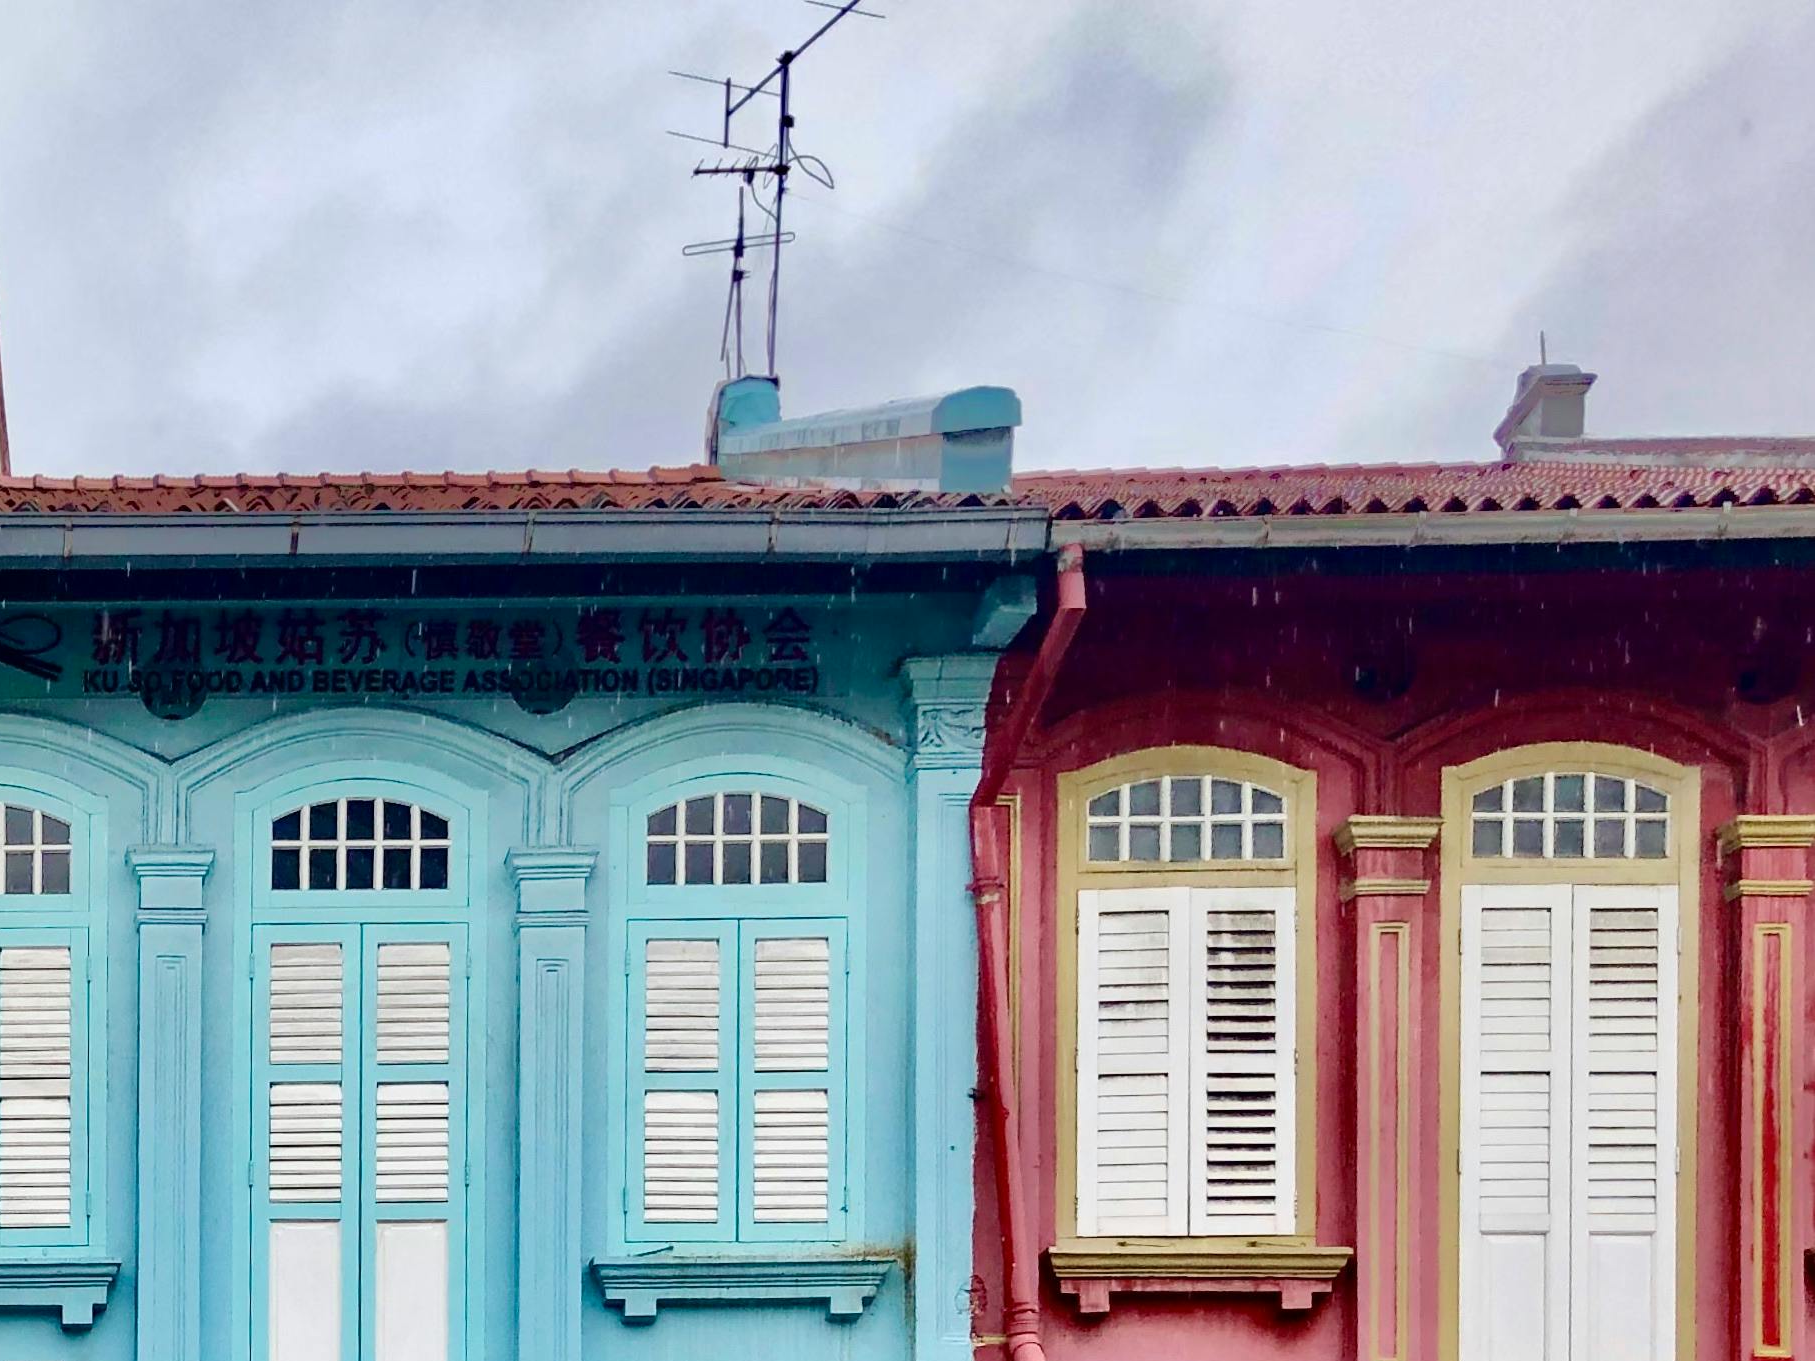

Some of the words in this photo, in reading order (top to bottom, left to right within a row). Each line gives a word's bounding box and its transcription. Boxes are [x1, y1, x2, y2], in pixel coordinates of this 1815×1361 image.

[83, 671, 119, 692] KU
[171, 671, 242, 692] FOOD
[250, 671, 305, 692] AND
[312, 670, 455, 693] BEVERAGE
[461, 670, 638, 693] ASSOCIATION
[647, 669, 820, 694] (SINGAPORE)
